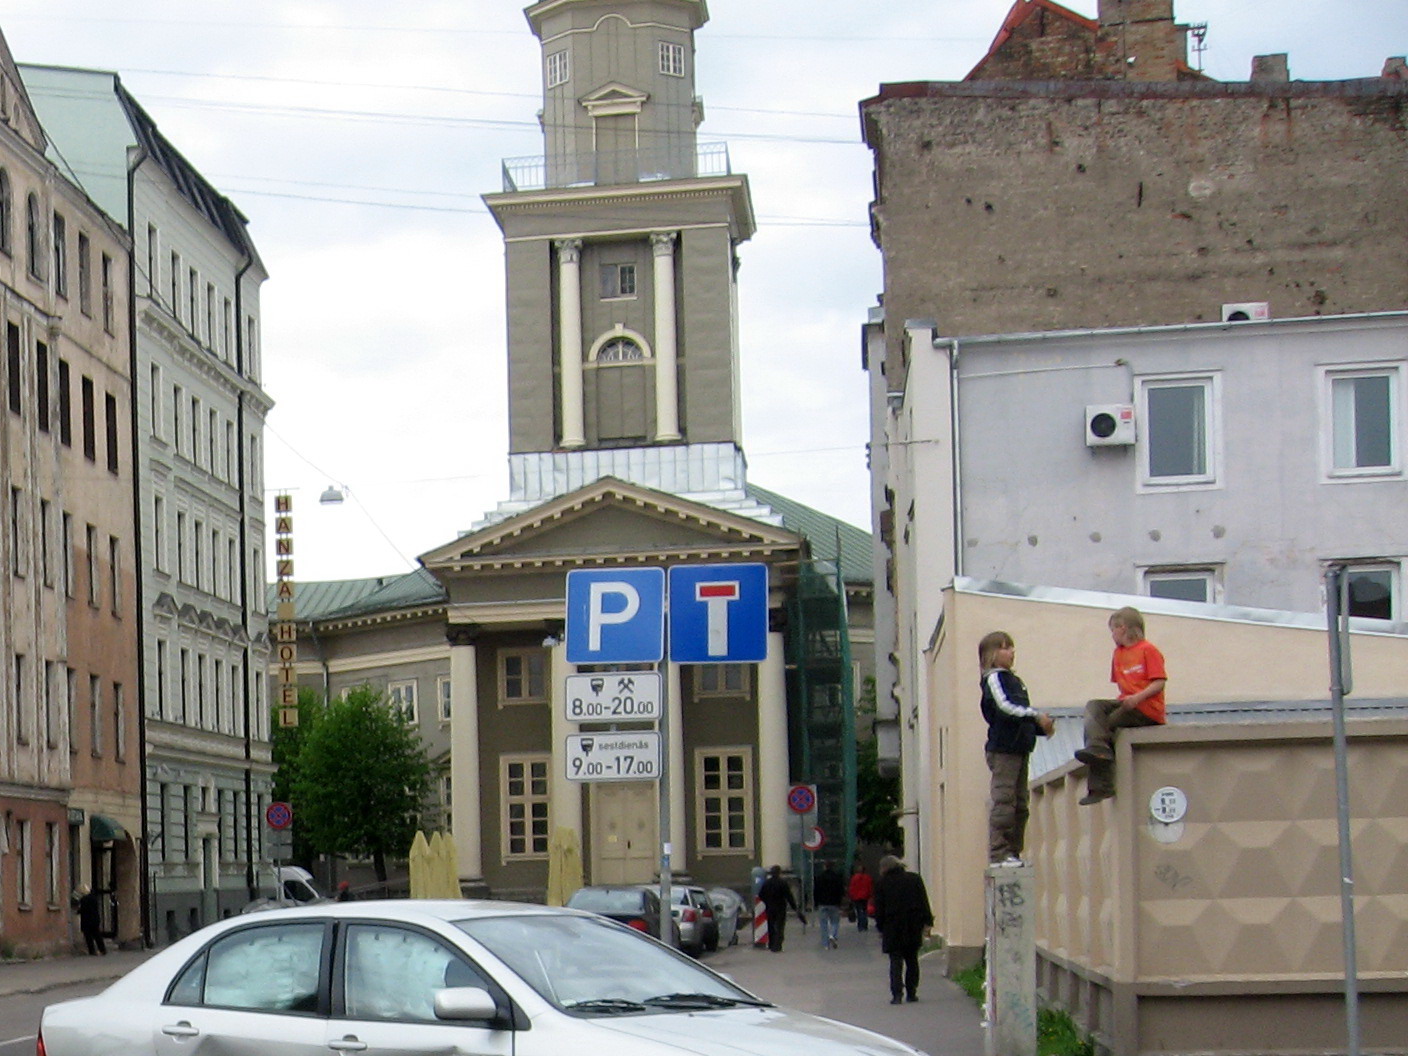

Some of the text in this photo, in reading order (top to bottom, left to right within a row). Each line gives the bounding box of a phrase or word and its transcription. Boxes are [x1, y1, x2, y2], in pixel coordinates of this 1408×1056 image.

[277, 495, 293, 598] HANZA
[588, 581, 641, 652] P
[279, 622, 295, 726] HOTEL
[572, 696, 655, 716] 8.00-20.00
